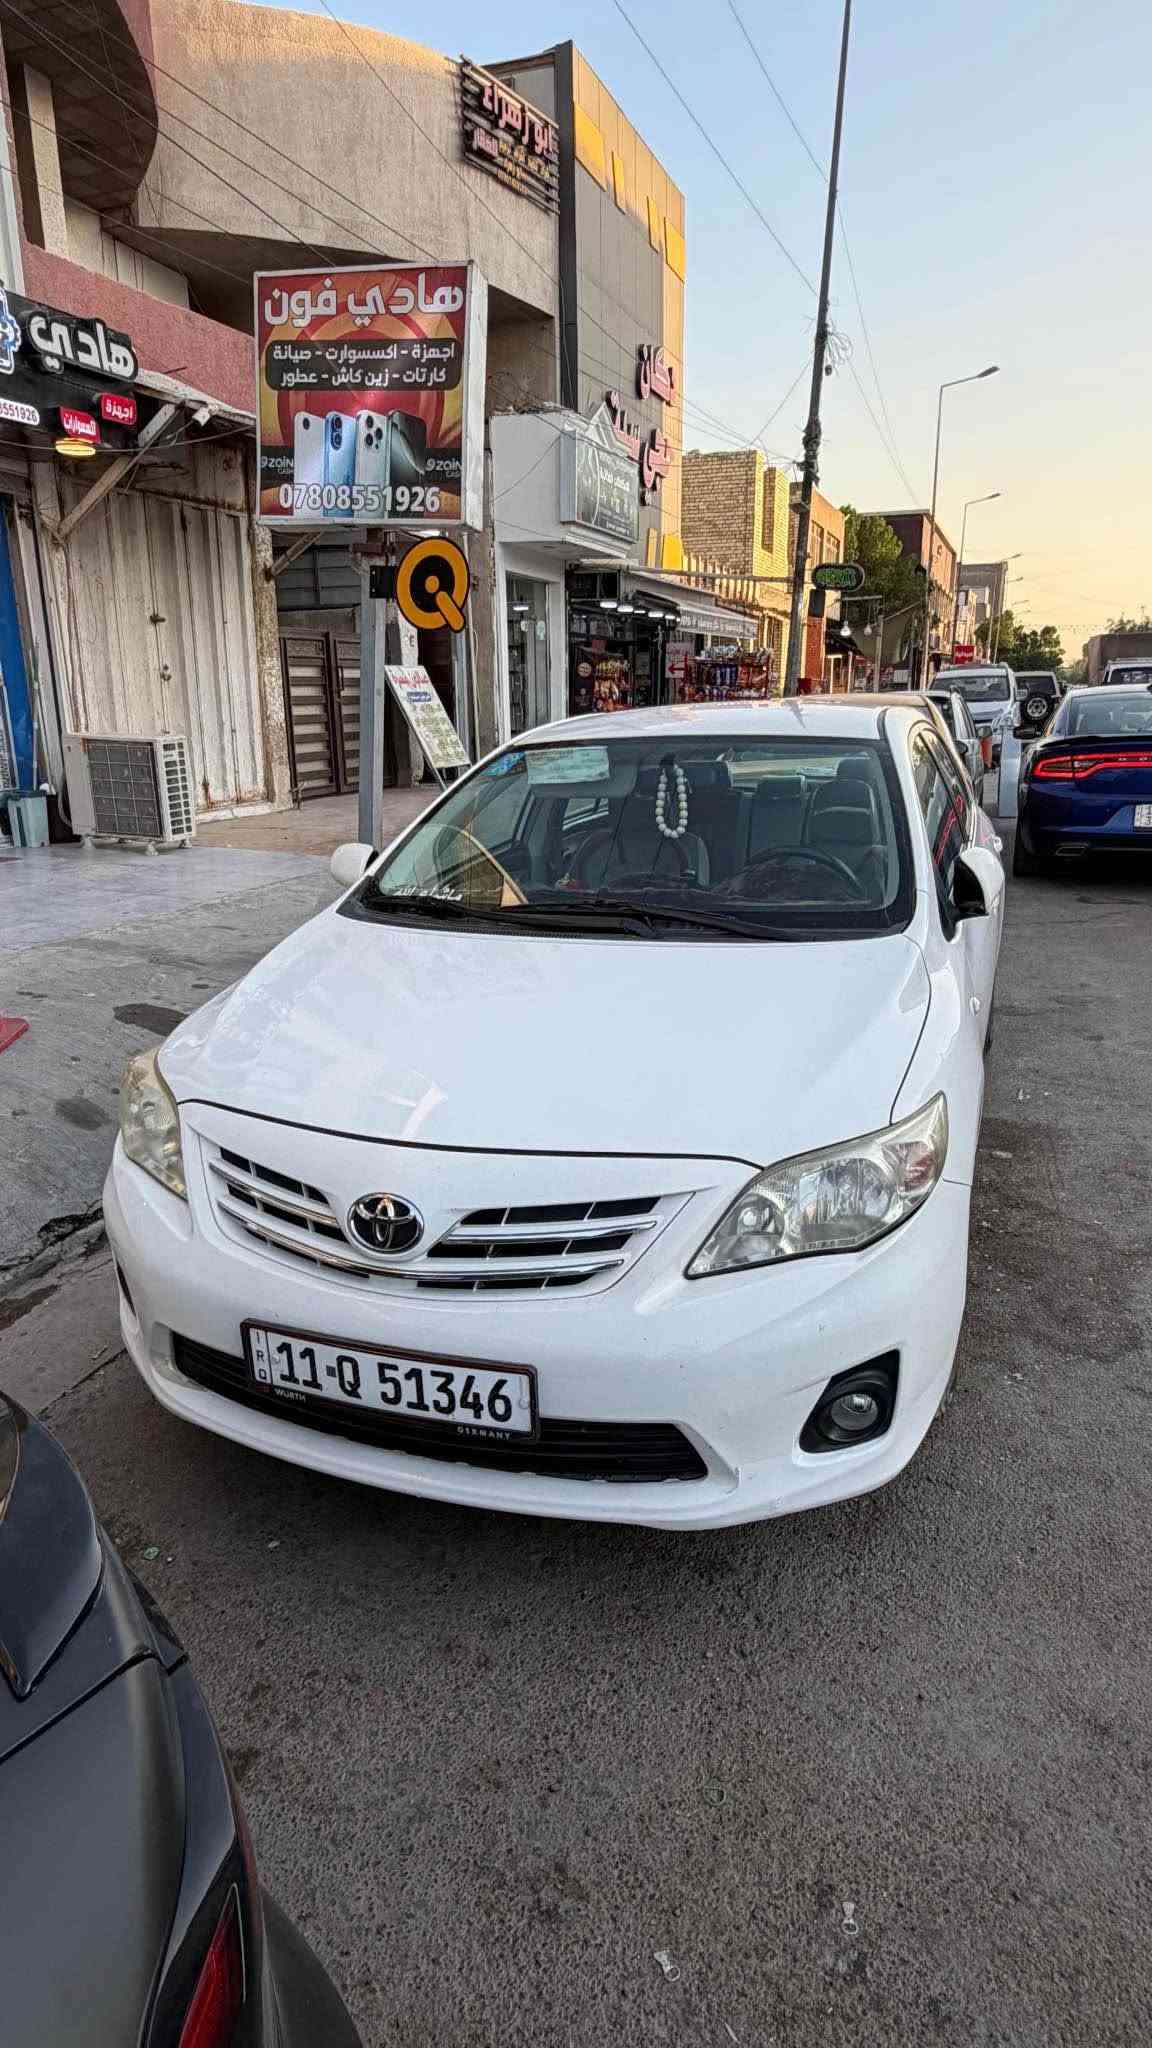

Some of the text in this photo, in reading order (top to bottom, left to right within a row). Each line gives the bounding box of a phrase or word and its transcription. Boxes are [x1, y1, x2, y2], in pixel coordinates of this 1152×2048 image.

[264, 272, 464, 328] هادي فون
[29, 315, 135, 378] هادي
[273, 344, 312, 364] صيانة
[411, 342, 455, 364] اجهزة
[280, 366, 447, 387] كارتات زين كاش عطور
[105, 399, 133, 420] اجهزة
[279, 482, 441, 513] 07808551926
[276, 1342, 513, 1422] 11-Q 51346
